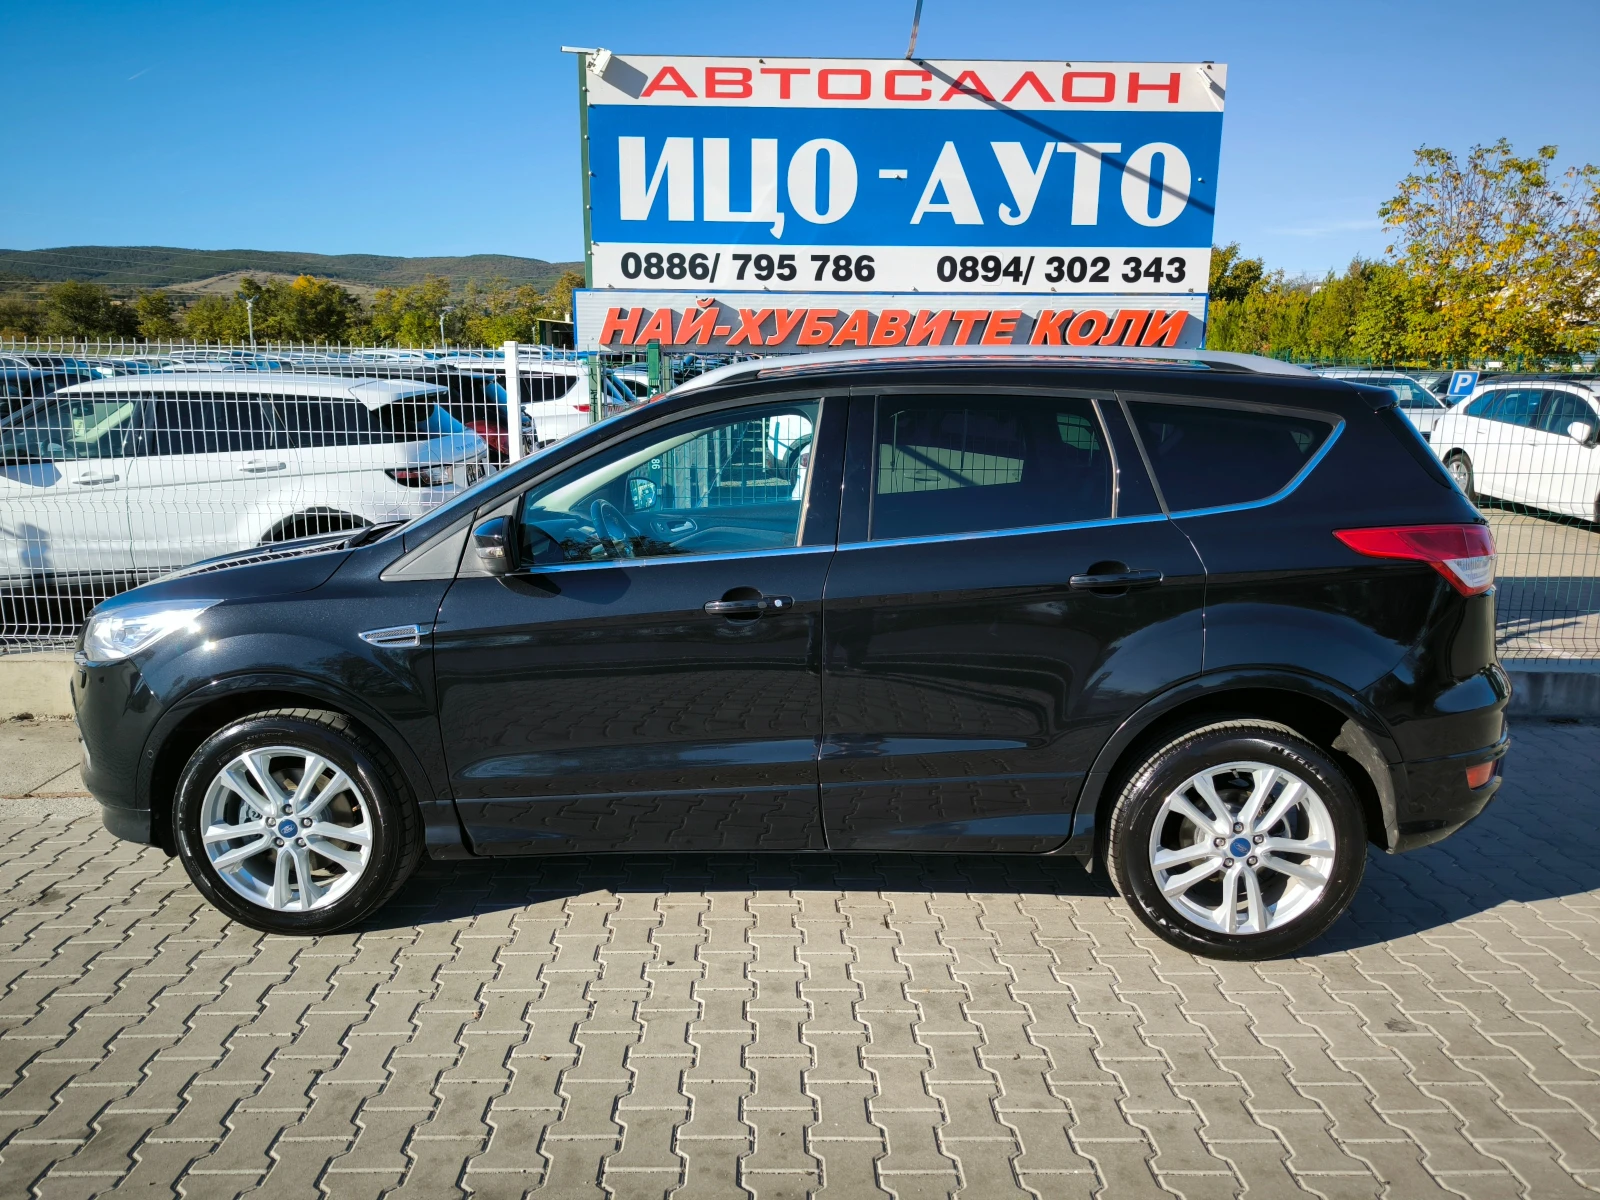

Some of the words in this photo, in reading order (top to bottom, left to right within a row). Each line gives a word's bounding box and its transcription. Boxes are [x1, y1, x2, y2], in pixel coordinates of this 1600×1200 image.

[640, 66, 1181, 103] АВТОСАЛОН
[618, 136, 858, 239] ИЦО
[910, 141, 1192, 227] АУТО
[620, 252, 720, 283] 0886/
[732, 254, 797, 281] 795
[810, 255, 875, 282] 786
[936, 255, 1035, 285] 0894/
[1044, 256, 1110, 283] 302
[1121, 256, 1186, 283] 343
[597, 297, 1022, 347] НАЙ-ХУБАВИТЕ
[1029, 309, 1190, 347] КОЛИ
[1454, 374, 1472, 393] P
